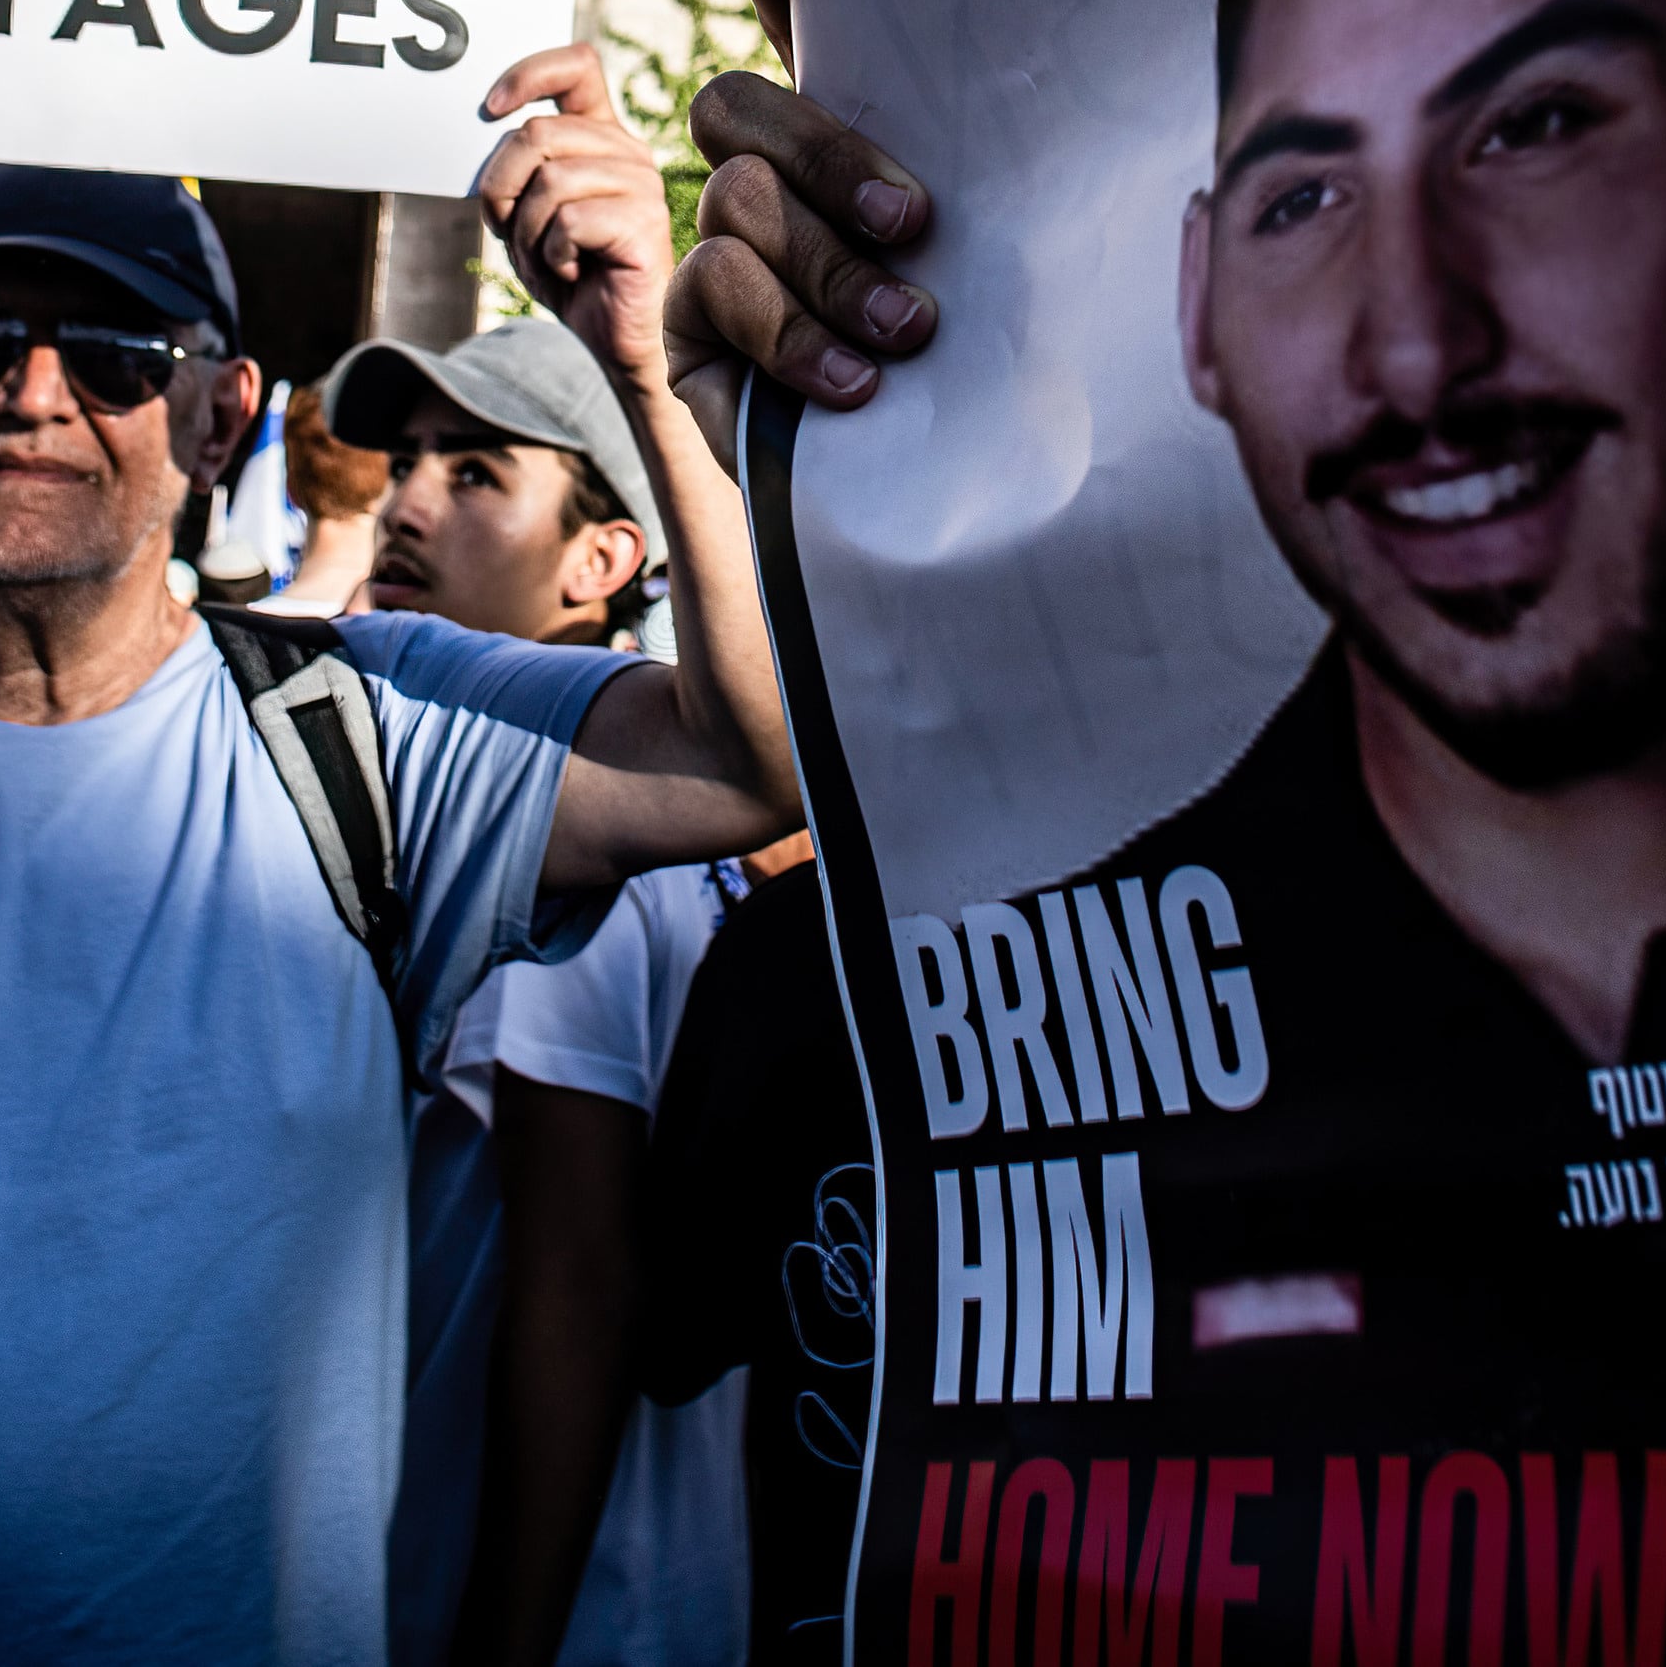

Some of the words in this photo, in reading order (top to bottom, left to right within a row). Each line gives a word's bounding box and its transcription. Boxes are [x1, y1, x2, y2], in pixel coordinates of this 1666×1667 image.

[890, 865, 1269, 1138] BRING
[933, 1151, 1154, 1404] HIM
[909, 1457, 1274, 1667] HOME
